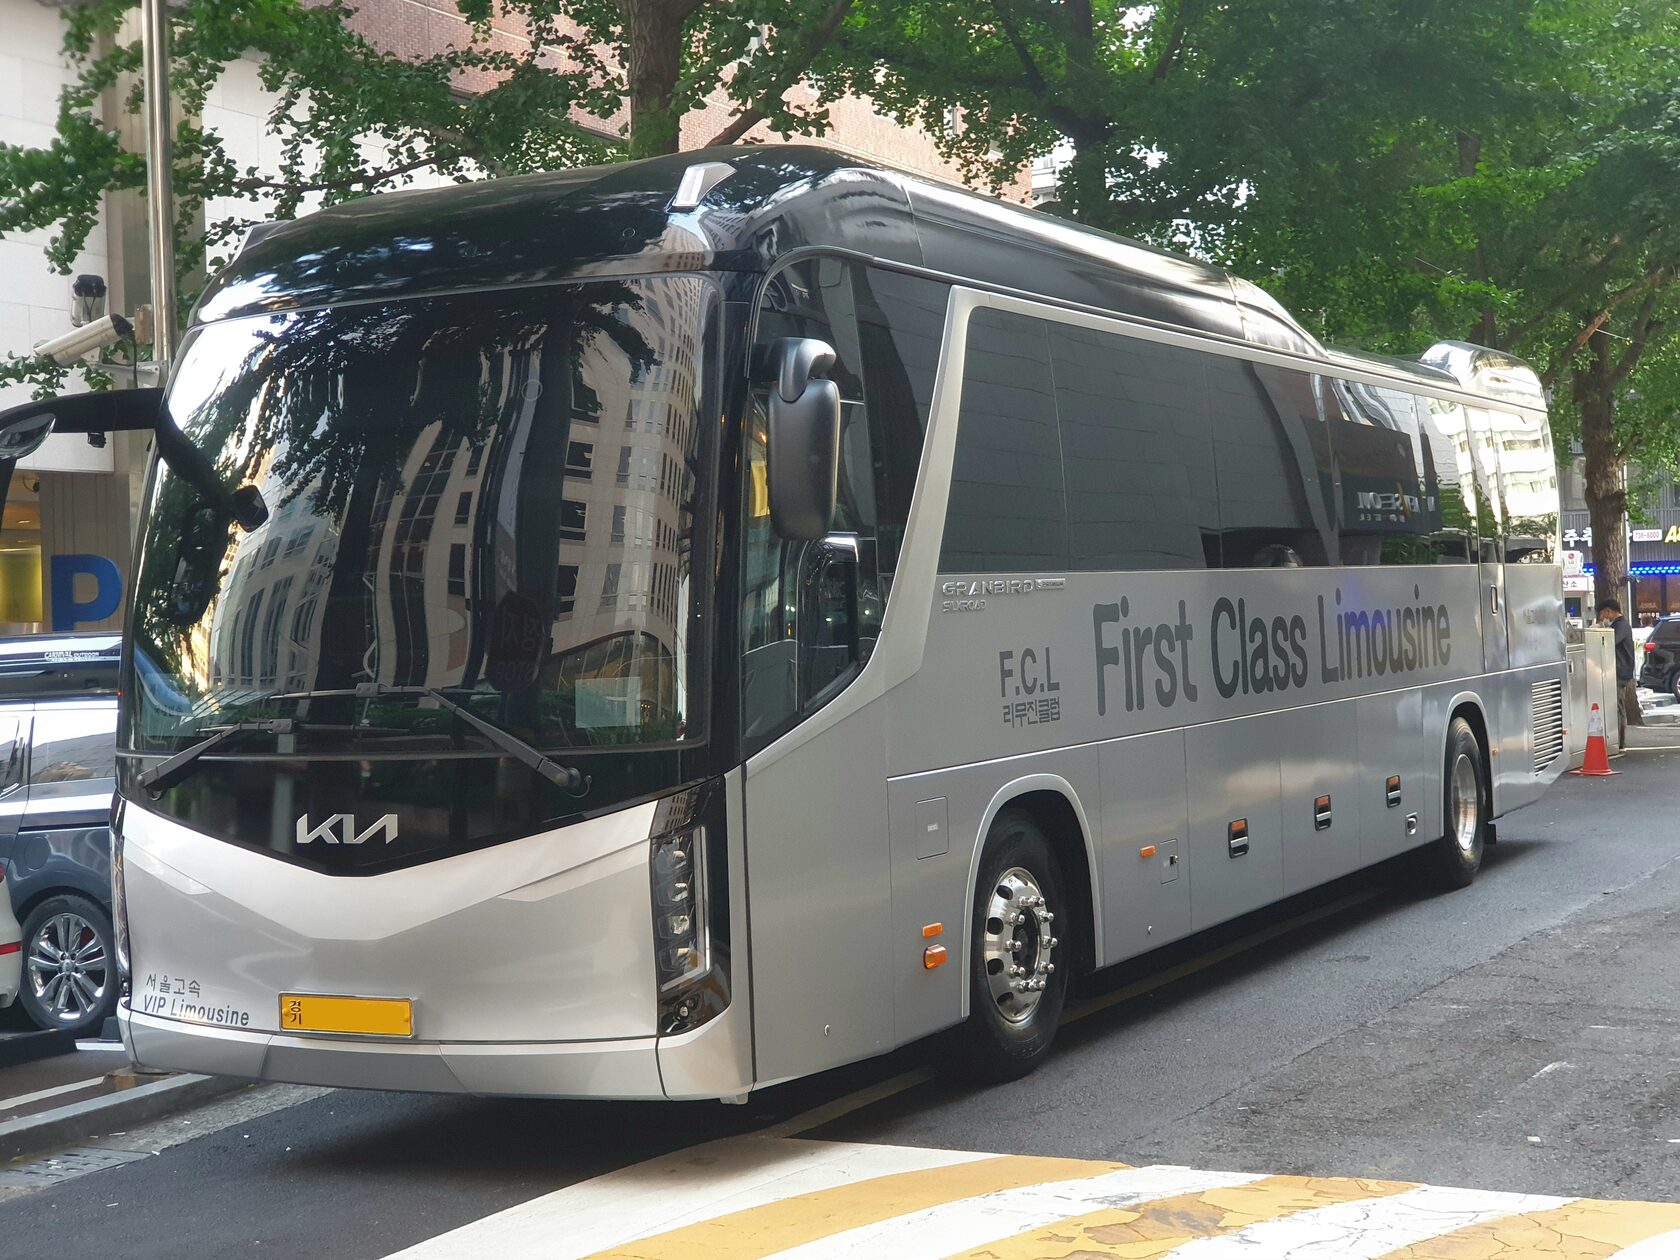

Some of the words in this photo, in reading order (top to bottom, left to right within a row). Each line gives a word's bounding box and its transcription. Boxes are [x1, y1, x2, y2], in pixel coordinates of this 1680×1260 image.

[51, 554, 122, 631] P
[942, 580, 1034, 596] GRANBIRD
[1093, 595, 1198, 716] First
[1211, 596, 1308, 699] Class
[1317, 584, 1452, 683] Limousine
[999, 647, 1060, 697] F.C.L
[1003, 696, 1060, 728] 리무진클럽
[297, 813, 398, 844] KIA
[146, 973, 200, 998] 서울고속
[144, 994, 166, 1014] VIP
[170, 998, 249, 1026] Limousine
